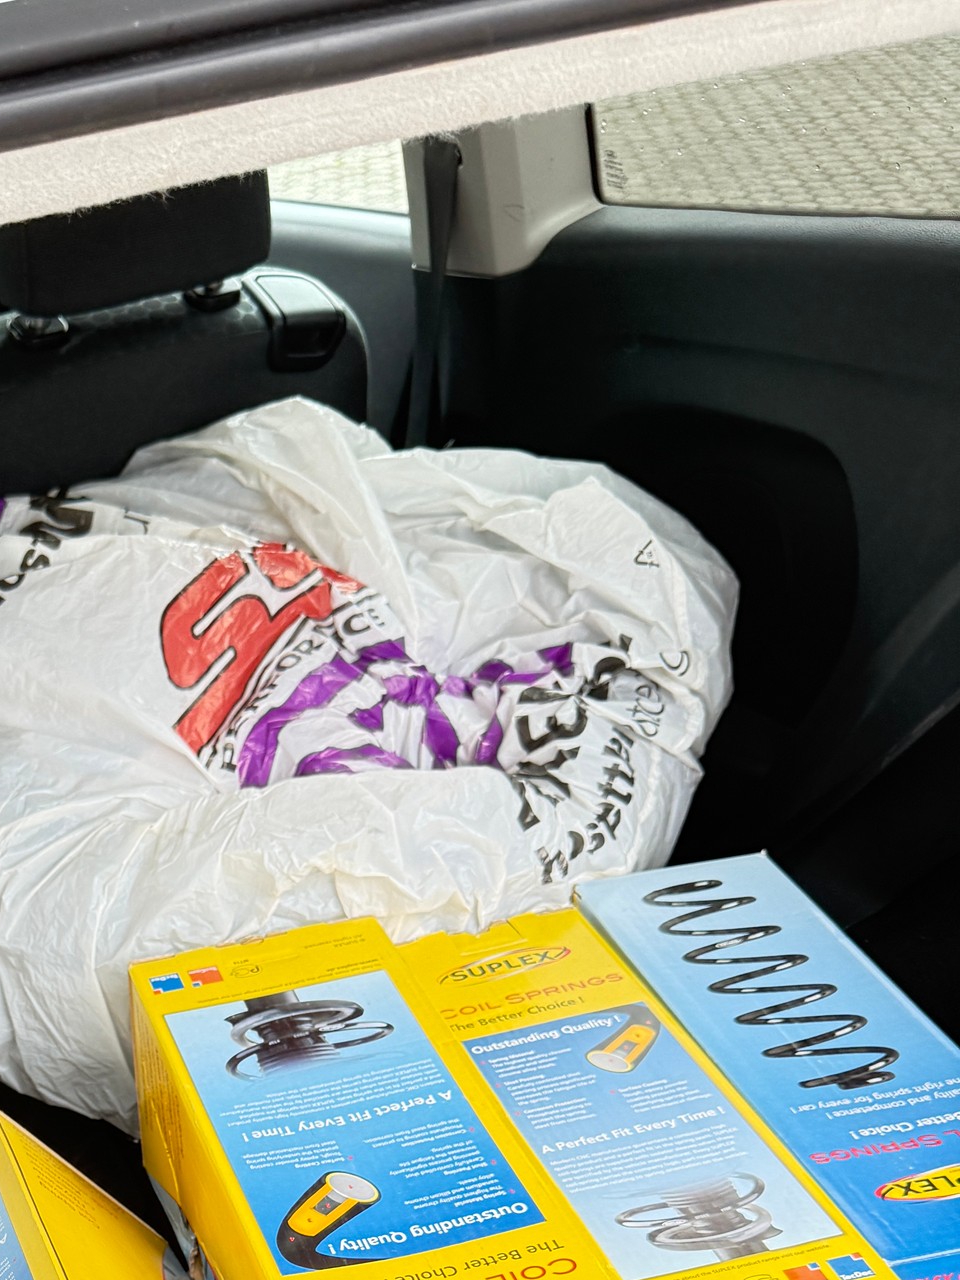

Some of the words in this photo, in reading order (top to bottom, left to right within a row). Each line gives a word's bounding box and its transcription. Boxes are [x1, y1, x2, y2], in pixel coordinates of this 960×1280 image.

[449, 950, 555, 982] SUPLEX
[504, 972, 623, 1004] SPRINGS
[477, 1010, 522, 1026] Better
[526, 999, 576, 1014] Choice
[471, 1029, 560, 1054] Outstanding
[560, 1017, 612, 1034] Quality
[373, 1094, 436, 1116] Perfect
[437, 1089, 451, 1102] A
[298, 1115, 346, 1131] Every
[347, 1109, 372, 1122] Fit
[251, 1125, 295, 1138] Time
[541, 1144, 555, 1154] A
[554, 1132, 611, 1150] Perfect
[610, 1127, 634, 1138] Fit
[632, 1118, 676, 1133] Every
[676, 1109, 717, 1123] Time
[859, 1122, 915, 1136] Choice
[809, 1134, 942, 1164] SPRINGS
[409, 1202, 528, 1237] Outstanding
[339, 1230, 407, 1251] Quality
[525, 1239, 564, 1253] The
[463, 1249, 522, 1270] Better
